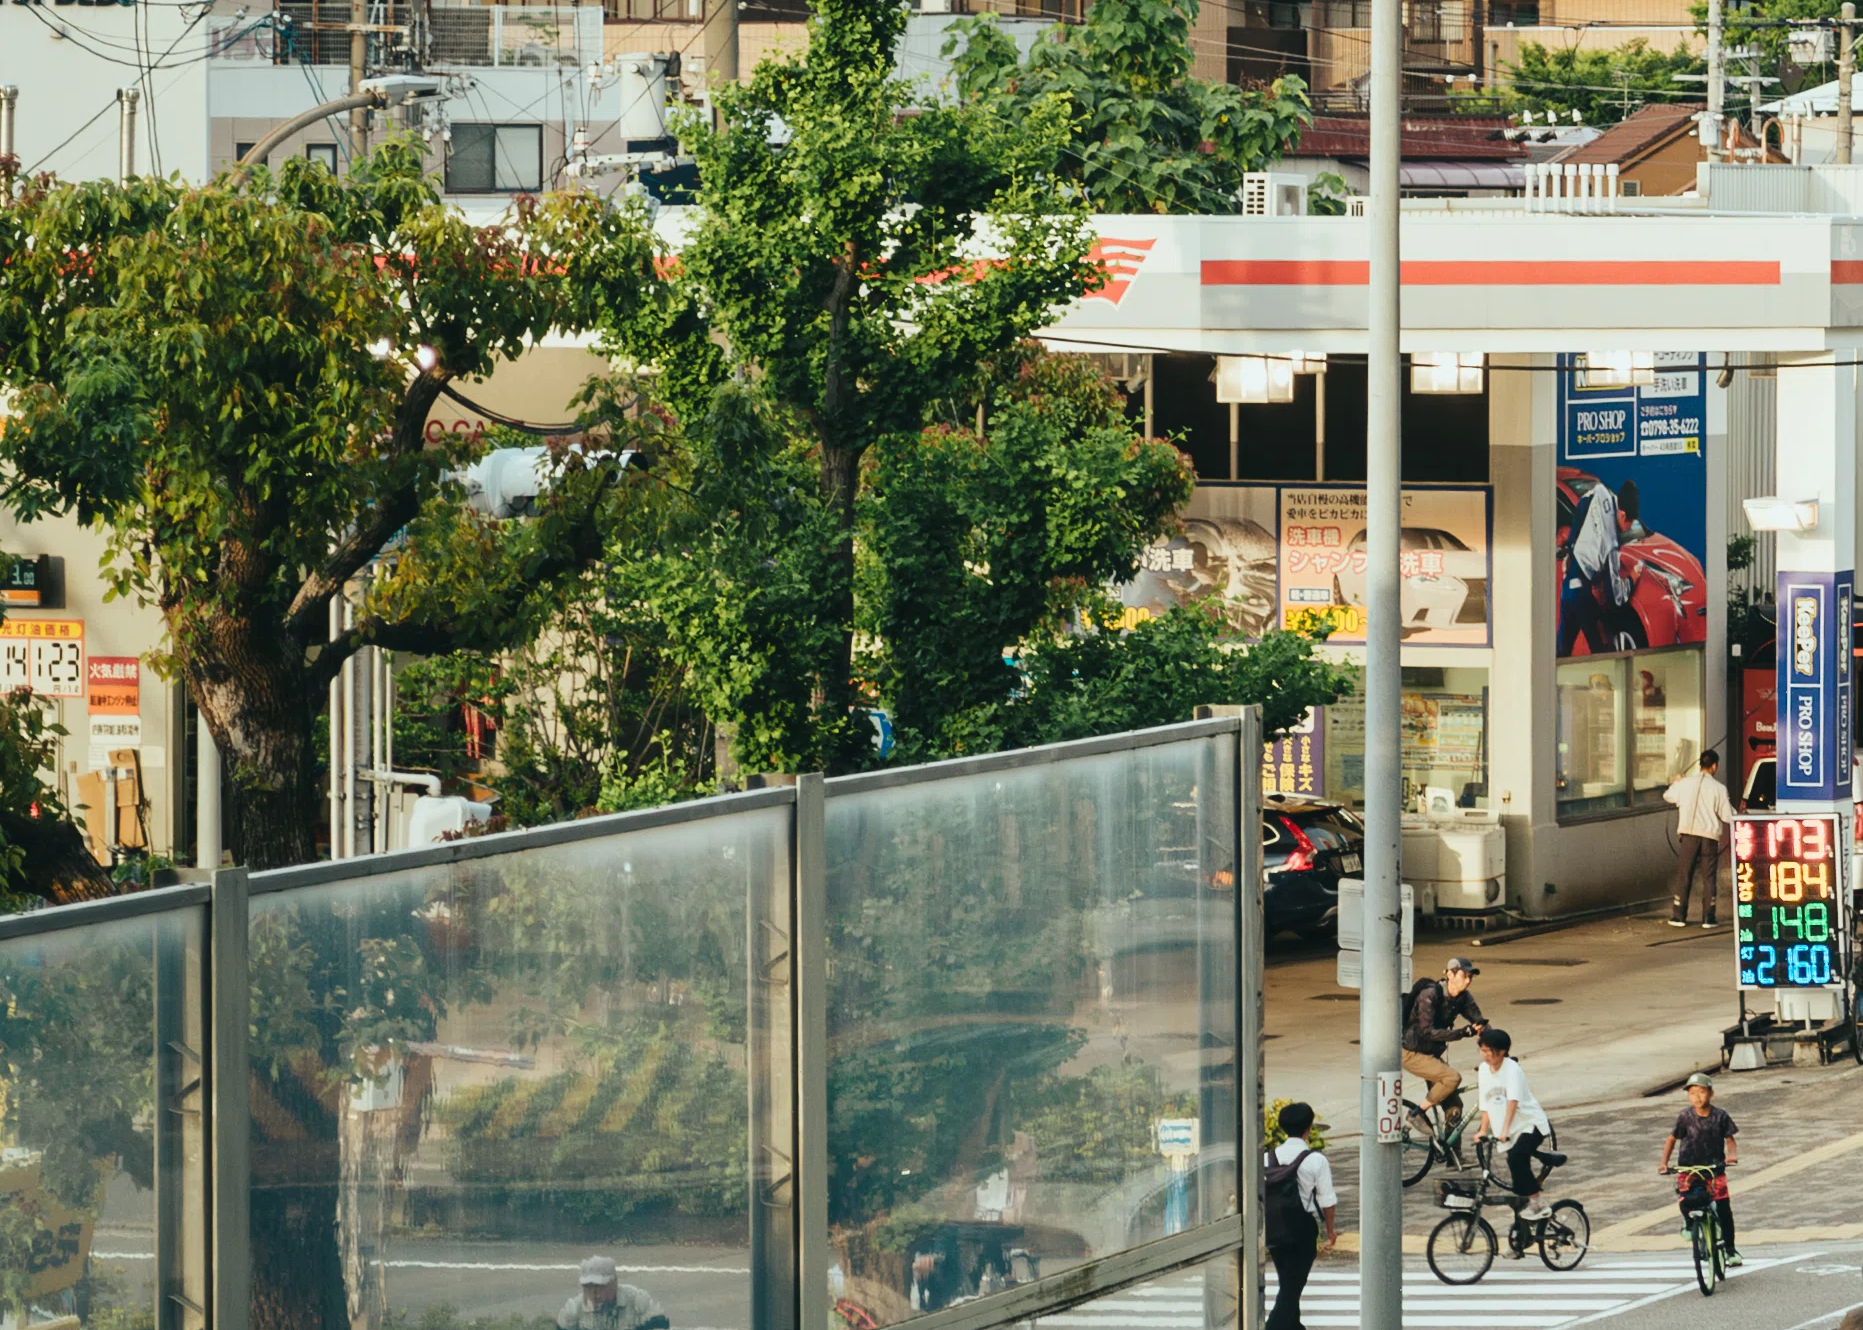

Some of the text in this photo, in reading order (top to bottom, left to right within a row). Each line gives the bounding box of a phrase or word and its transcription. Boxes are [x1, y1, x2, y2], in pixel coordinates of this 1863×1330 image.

[1577, 410, 1626, 431] PRO SHOP
[1287, 526, 1341, 546] 洗車機
[1794, 597, 1817, 676] KeePer
[38, 643, 80, 681] 123
[89, 663, 138, 680] 火気厳禁
[1798, 695, 1812, 776] PRO SHOP
[1767, 819, 1825, 860] 173
[1769, 861, 1828, 901] 184
[1772, 902, 1829, 942] 148
[1757, 944, 1831, 985] 2160
[1382, 1079, 1402, 1097] 18
[1387, 1098, 1398, 1115] 3
[1380, 1116, 1402, 1134] 04
